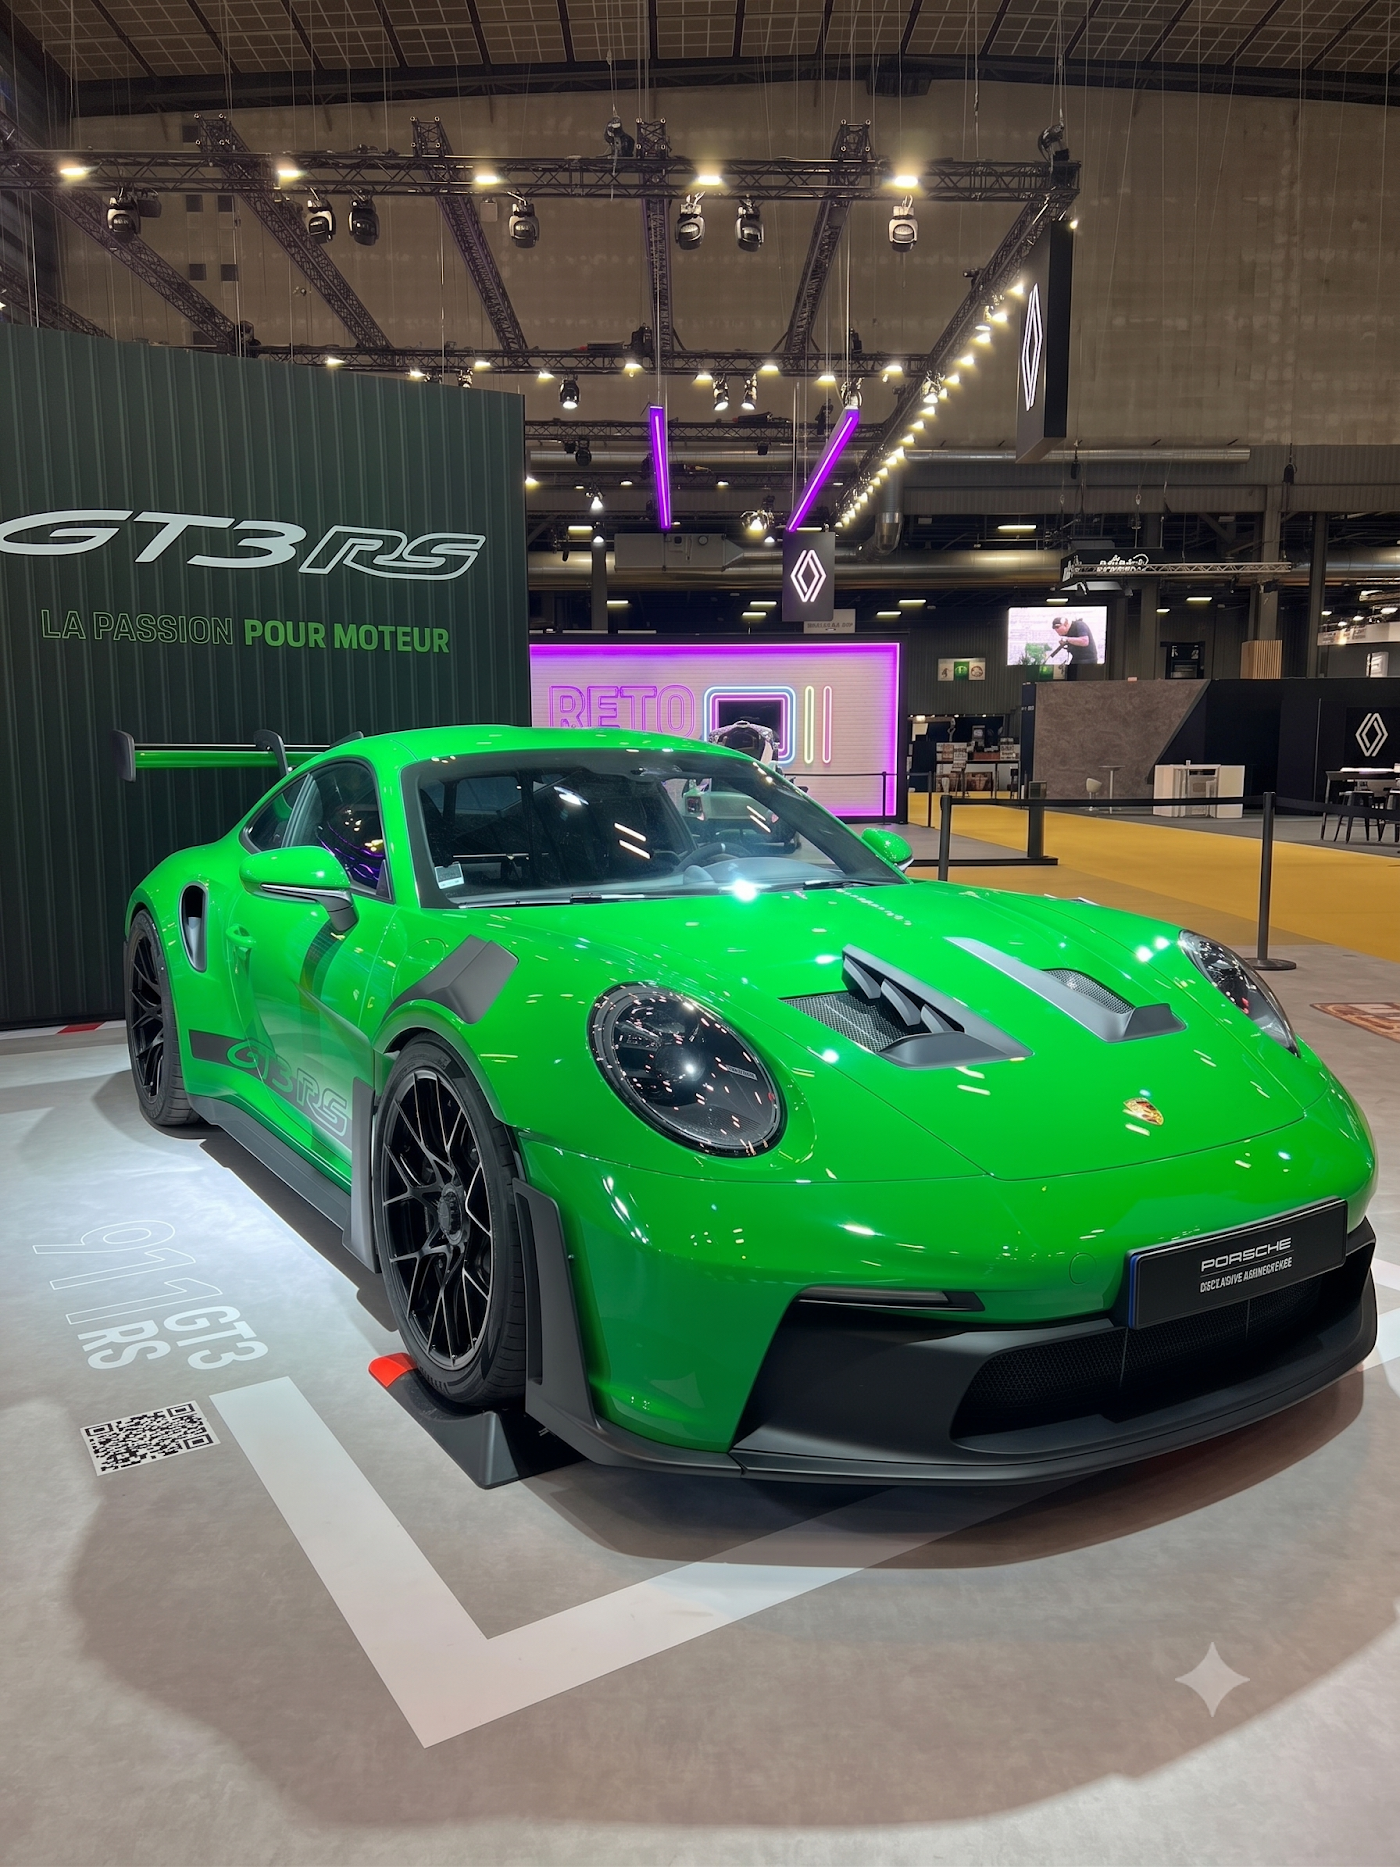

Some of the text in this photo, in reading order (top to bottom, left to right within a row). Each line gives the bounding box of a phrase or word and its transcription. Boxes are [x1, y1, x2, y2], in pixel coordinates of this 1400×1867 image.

[41, 609, 450, 654] LA PASSION POUR MOTEUR
[1201, 1237, 1292, 1273] PORSCHE
[77, 1319, 171, 1369] RS
[163, 1305, 269, 1370] GT3
